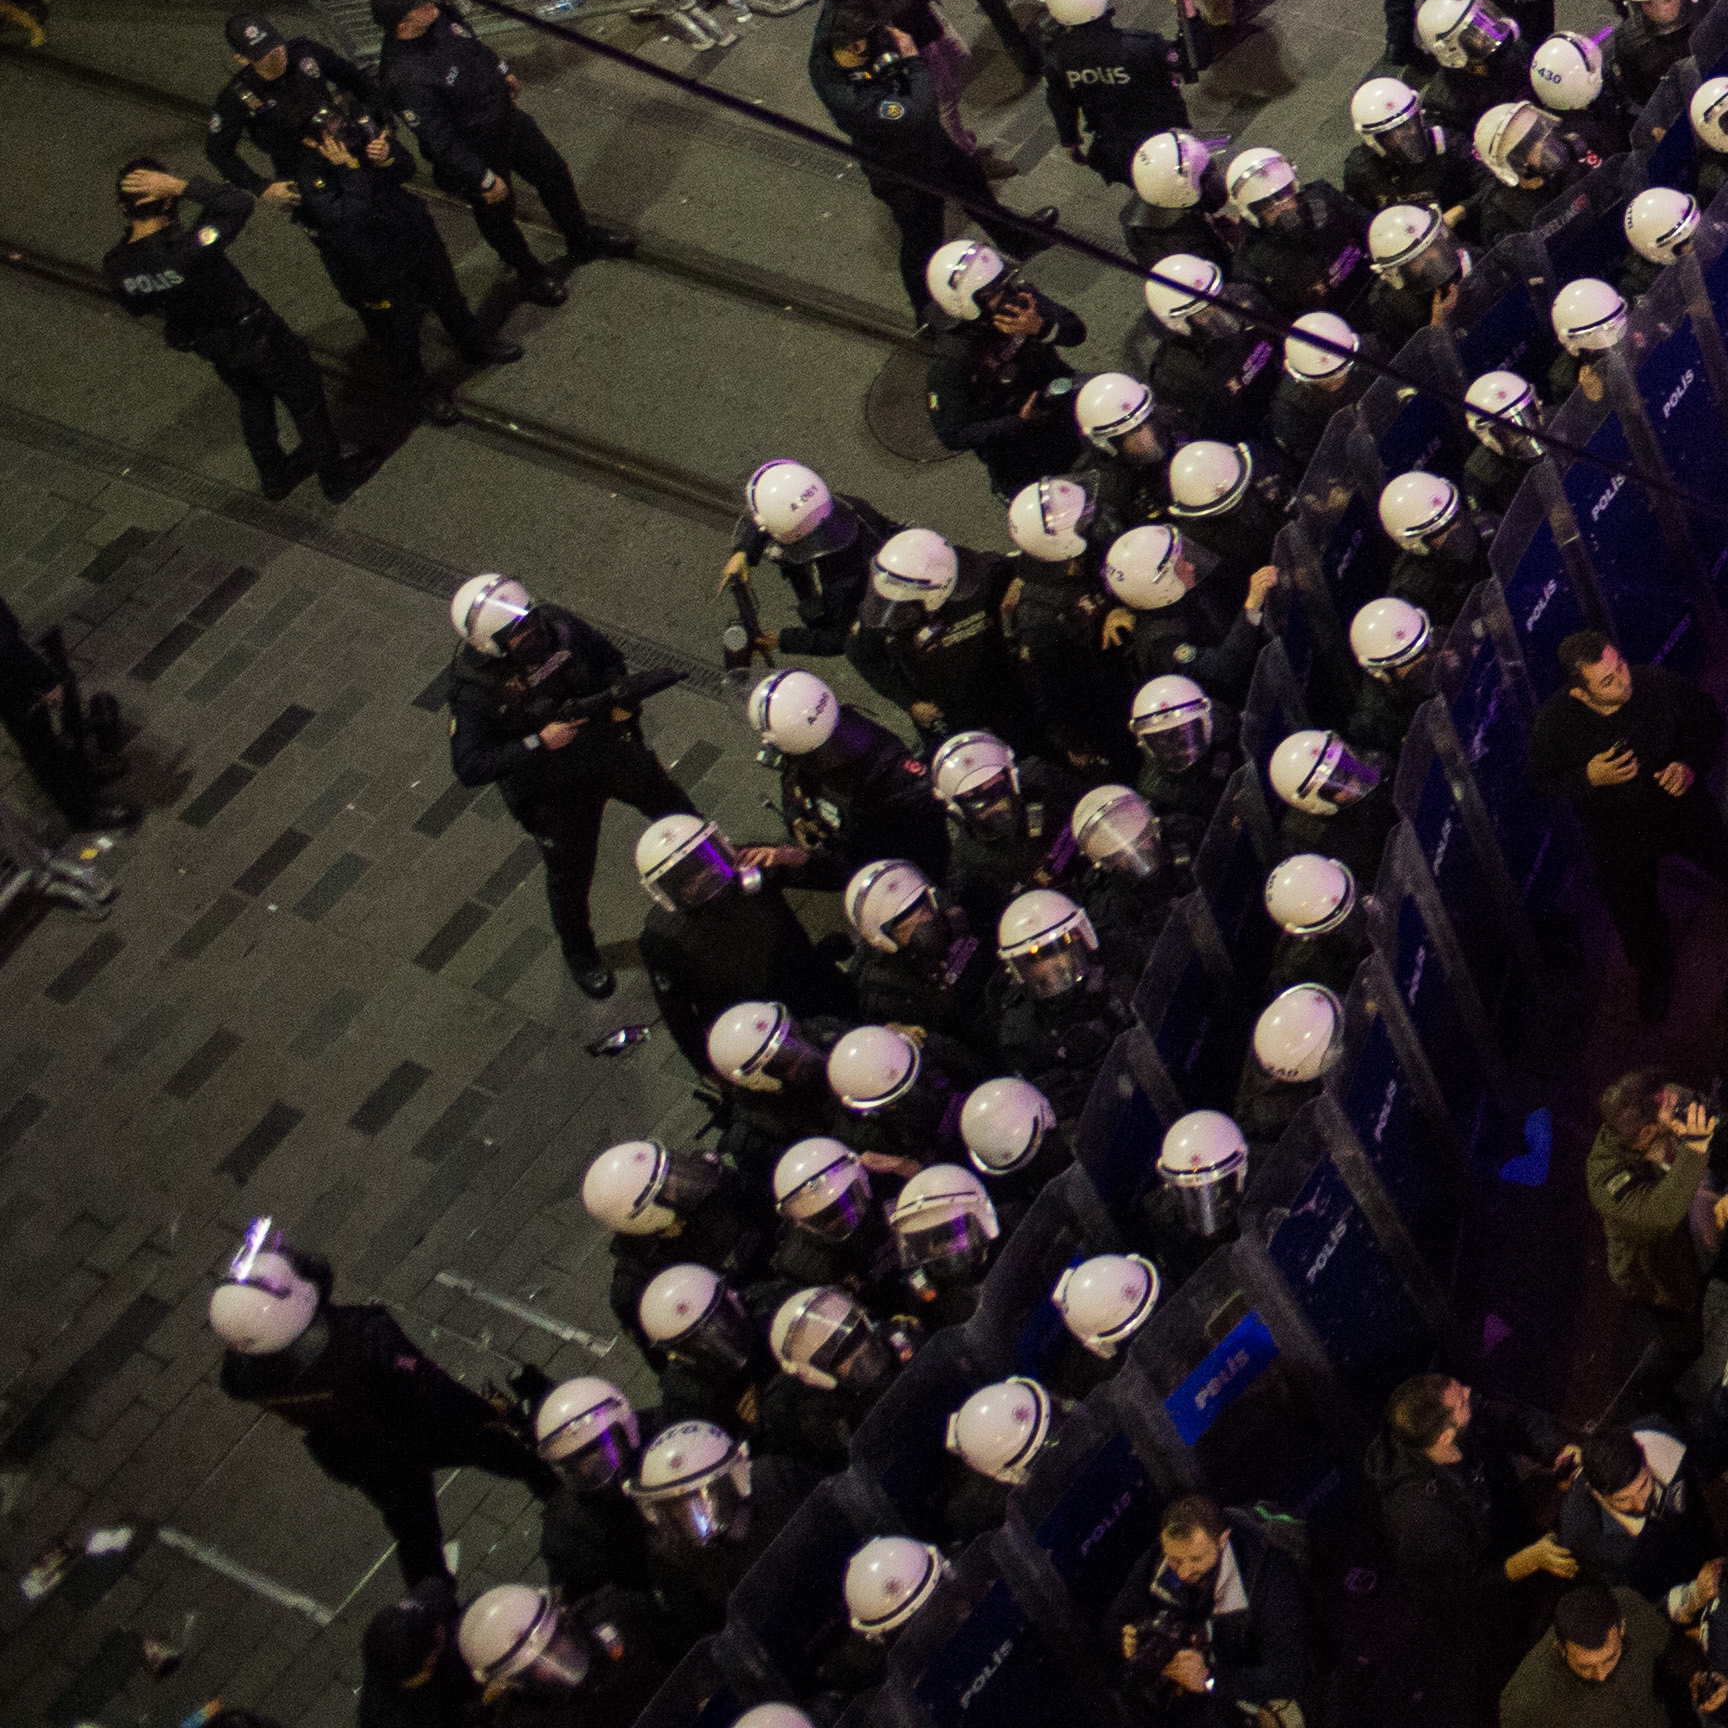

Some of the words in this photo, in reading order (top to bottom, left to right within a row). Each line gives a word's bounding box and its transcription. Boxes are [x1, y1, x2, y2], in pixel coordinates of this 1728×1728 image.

[1066, 65, 1132, 89] POLİS
[1662, 368, 1695, 420] POLİS
[1590, 474, 1628, 523] POLİS
[959, 1637, 1014, 1711] POLİS
